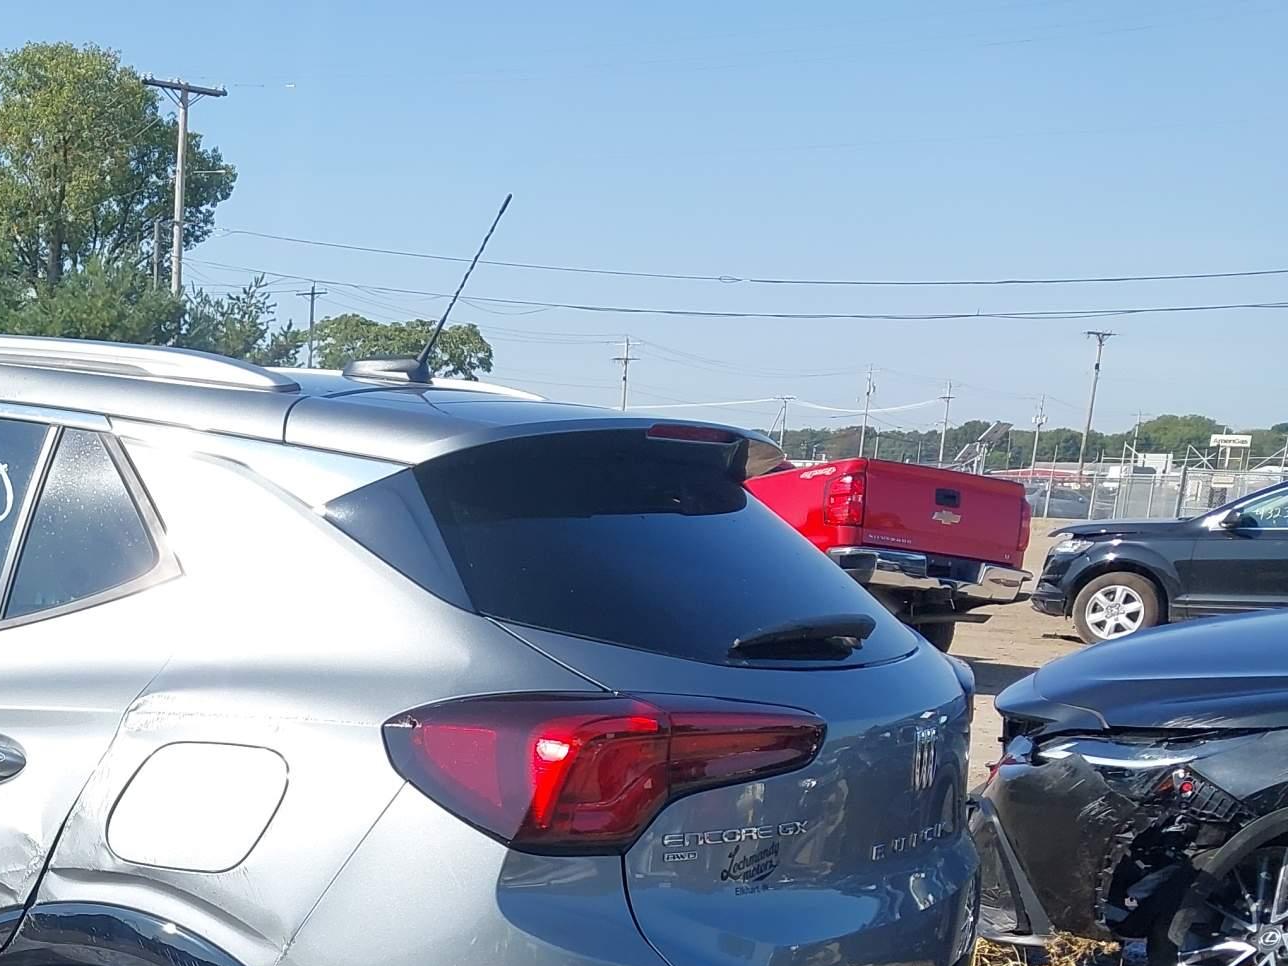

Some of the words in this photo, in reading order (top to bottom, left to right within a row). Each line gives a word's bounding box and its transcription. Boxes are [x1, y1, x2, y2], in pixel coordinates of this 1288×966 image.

[663, 825, 773, 847] ENCORE
[777, 820, 808, 836] GX
[664, 851, 697, 862] AWD
